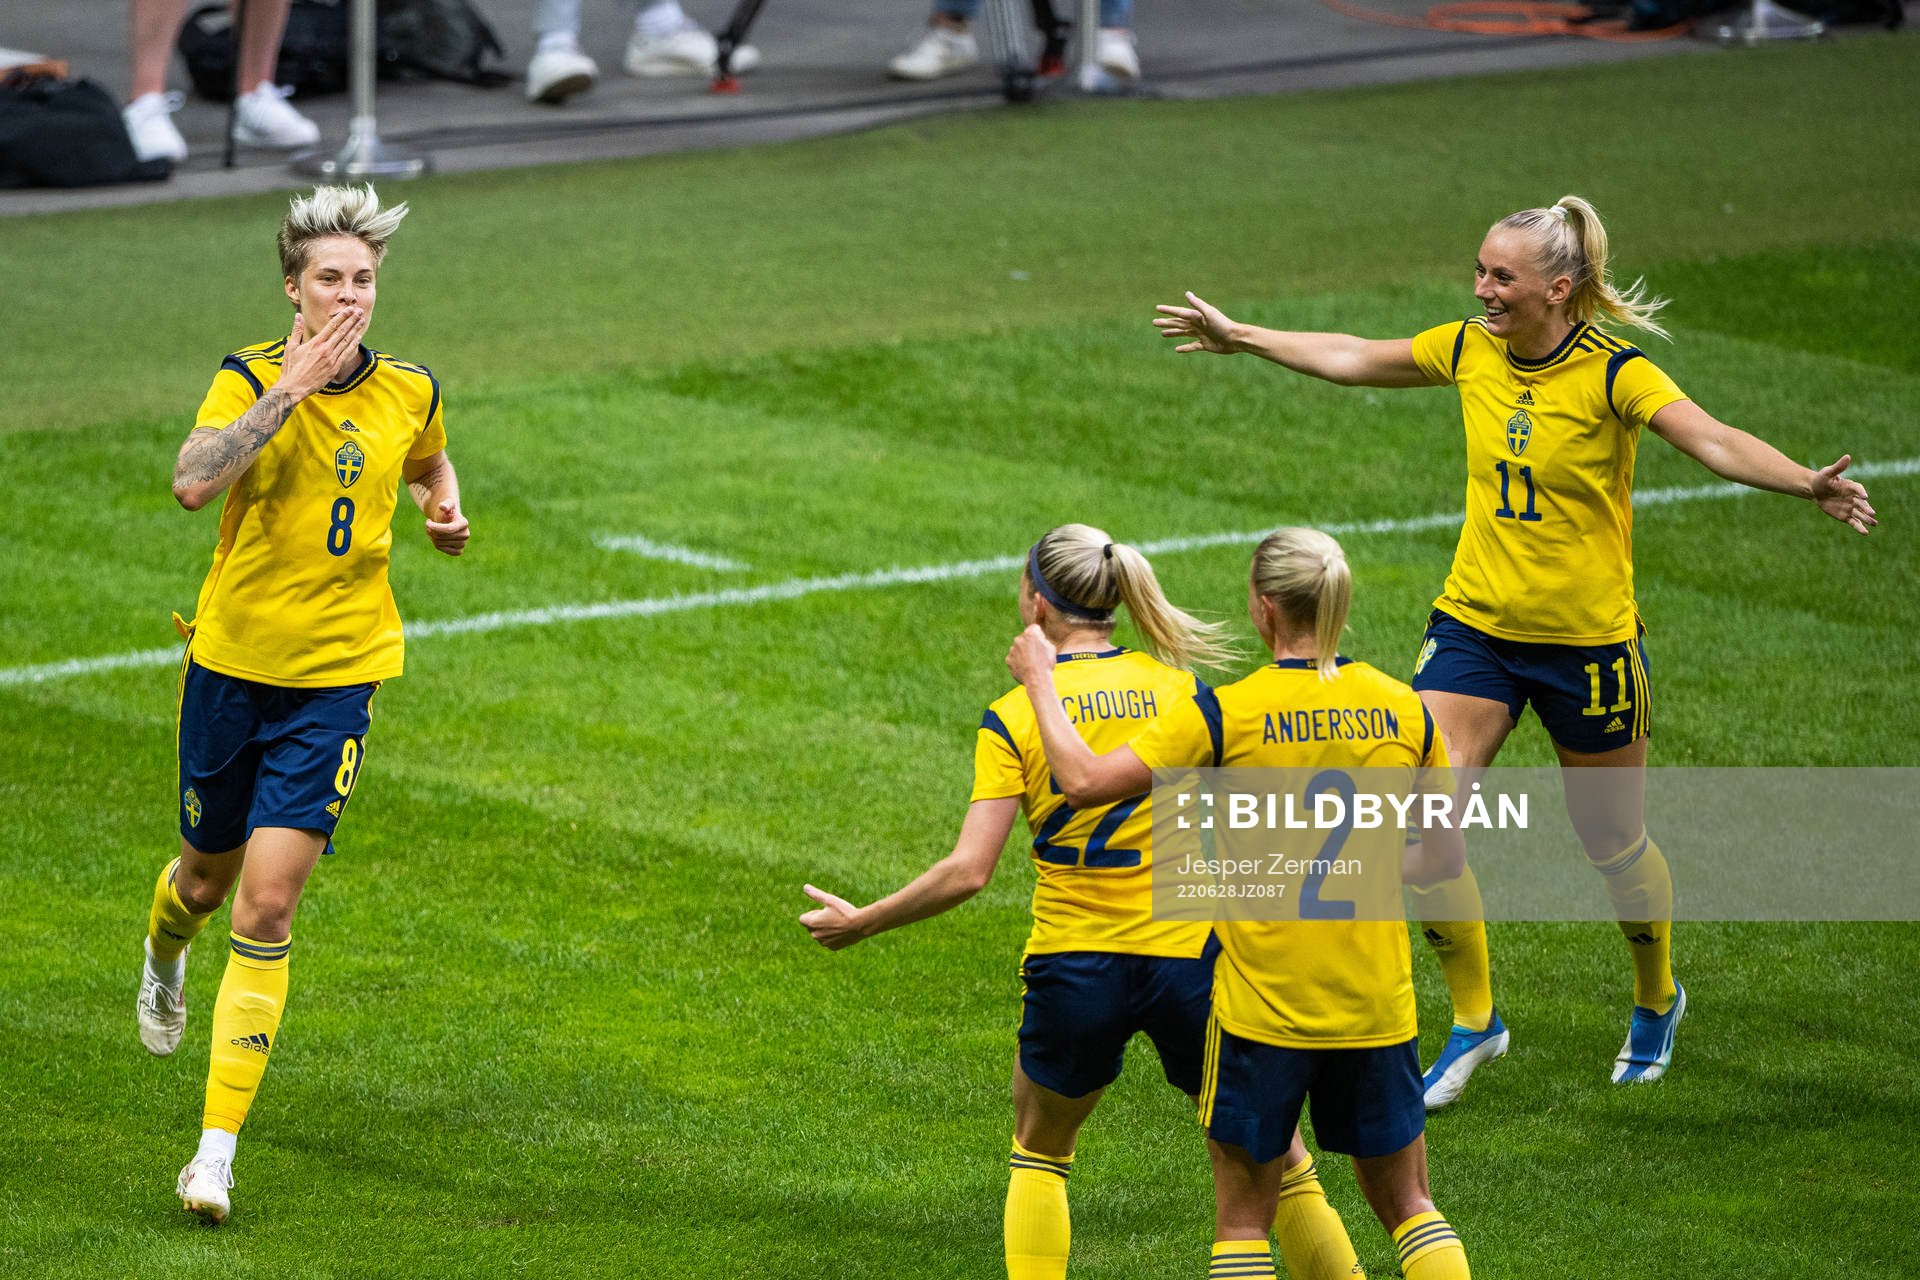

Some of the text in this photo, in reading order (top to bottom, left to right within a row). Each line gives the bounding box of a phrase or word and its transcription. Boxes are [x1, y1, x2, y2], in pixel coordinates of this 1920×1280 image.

[1495, 461, 1542, 521] 11
[327, 497, 355, 556] 8
[1583, 657, 1631, 715] 11
[1263, 707, 1400, 746] ANDERSSON
[335, 739, 357, 796] 8
[1299, 769, 1358, 919] 2
